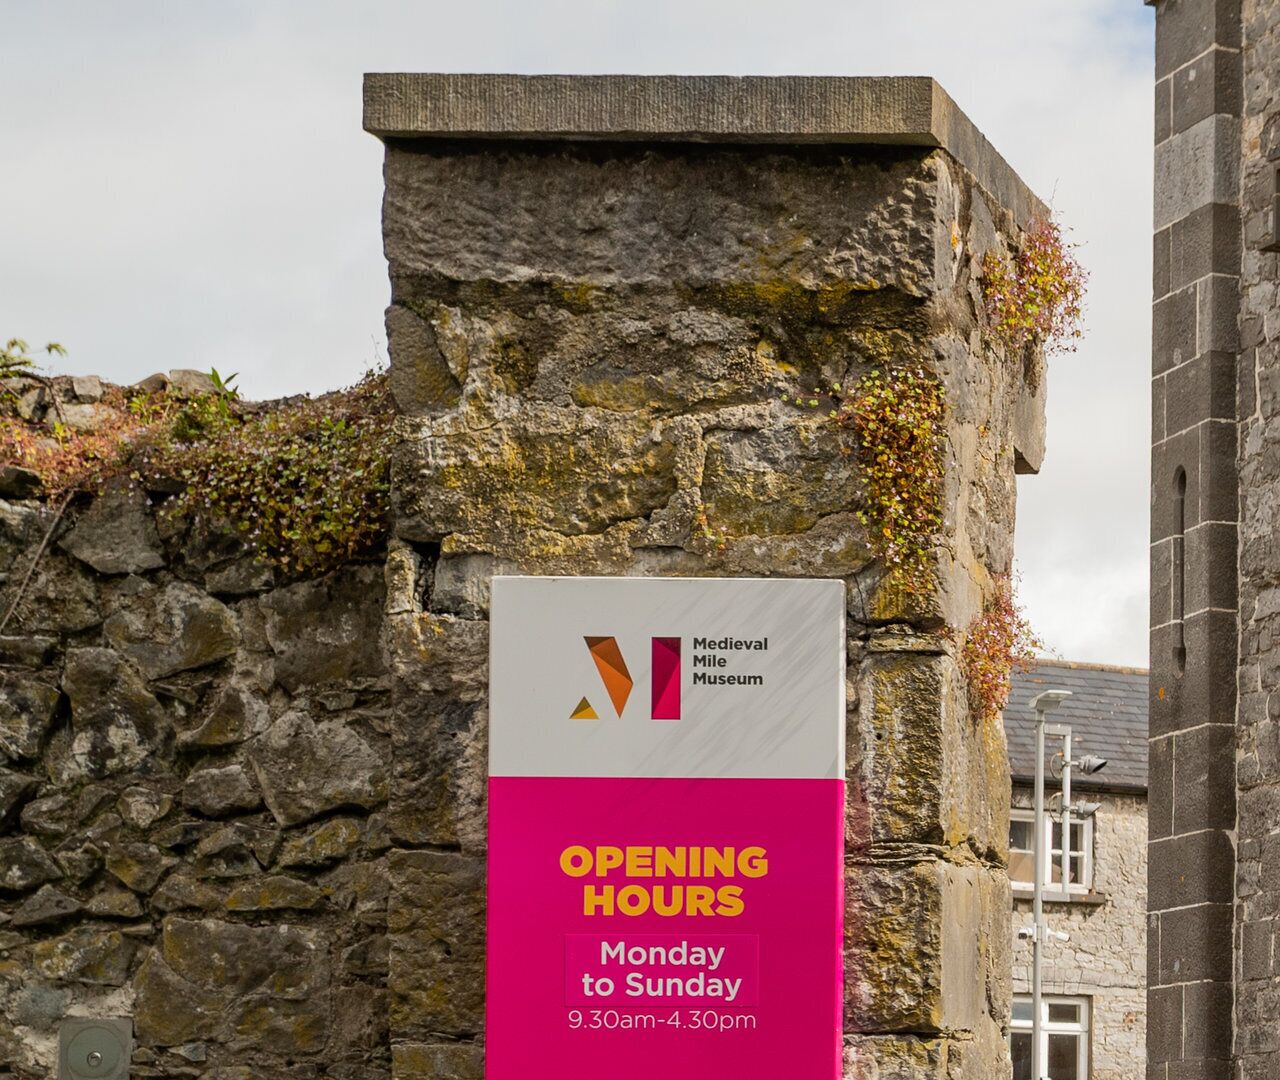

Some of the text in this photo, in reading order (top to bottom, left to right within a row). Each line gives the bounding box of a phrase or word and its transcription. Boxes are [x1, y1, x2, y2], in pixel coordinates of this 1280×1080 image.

[693, 636, 768, 651] Medieval
[693, 654, 728, 668] Mile
[693, 672, 764, 686] Museum
[559, 845, 769, 878] OPENING
[583, 884, 745, 917] HOURS
[600, 940, 726, 969] Monday
[581, 972, 743, 1003] to Sunday
[567, 1010, 757, 1033] 9.30am-4.30pm
